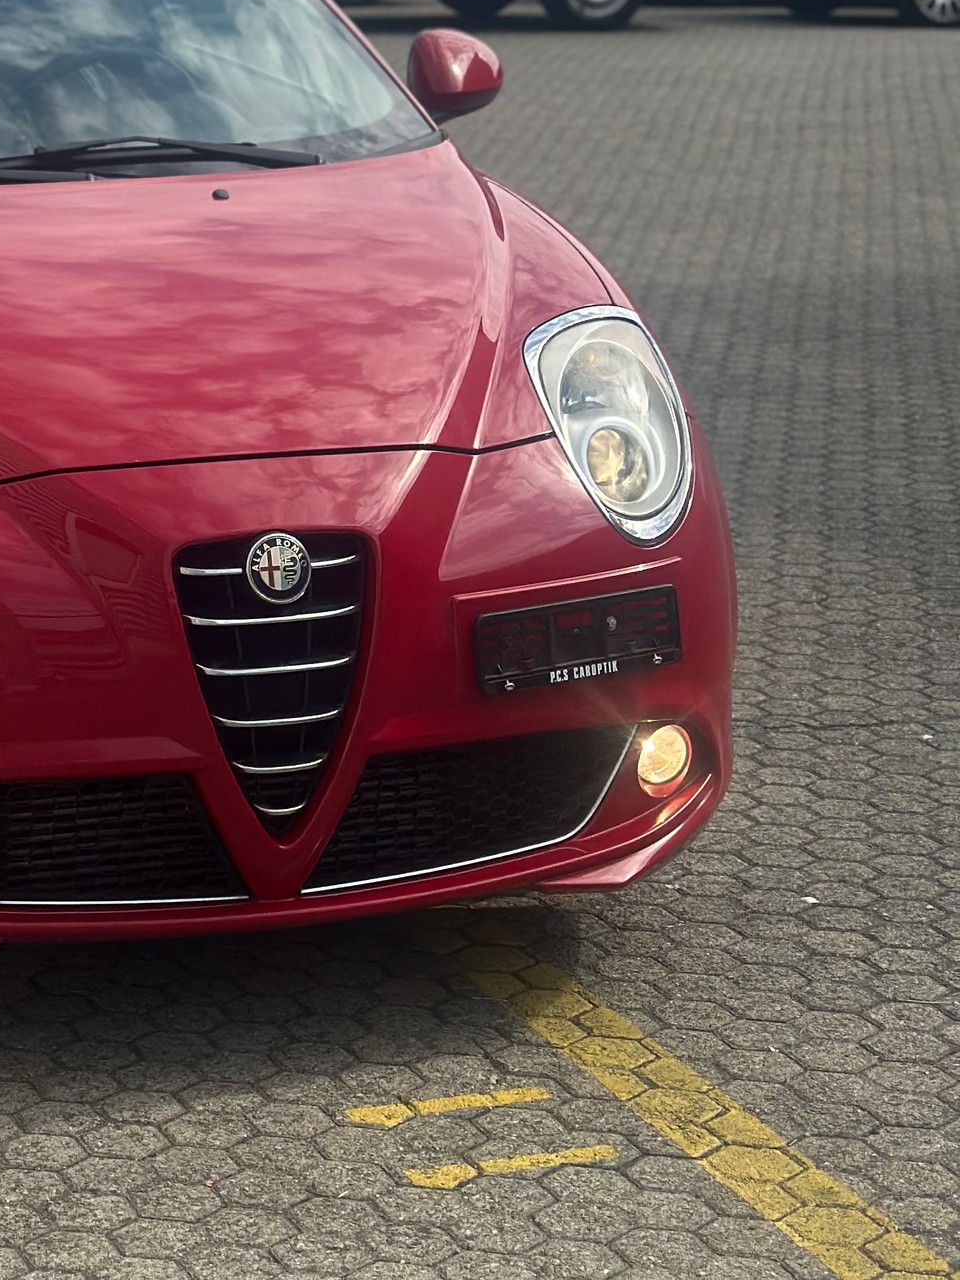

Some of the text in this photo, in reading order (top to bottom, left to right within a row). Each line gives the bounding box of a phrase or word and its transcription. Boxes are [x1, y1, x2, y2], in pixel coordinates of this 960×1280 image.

[251, 543, 271, 572] ALFA
[549, 660, 619, 683] P.C.S CAROPTIK
